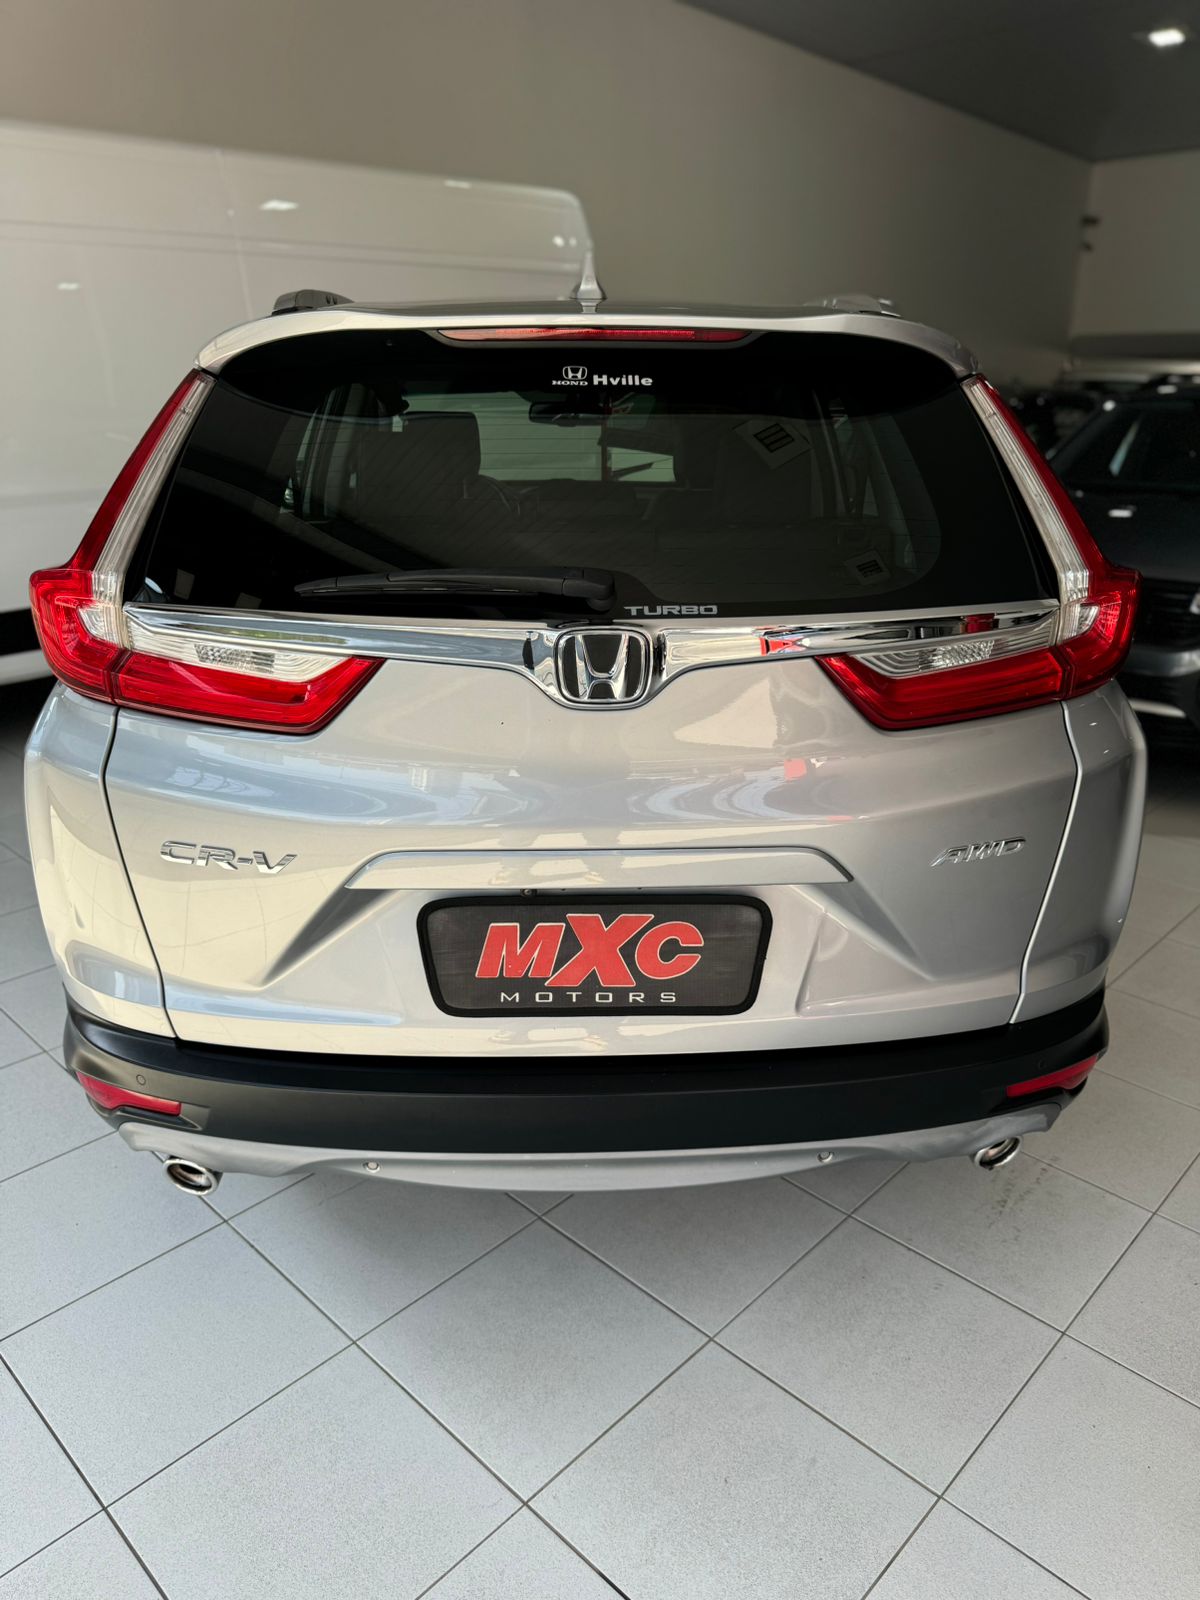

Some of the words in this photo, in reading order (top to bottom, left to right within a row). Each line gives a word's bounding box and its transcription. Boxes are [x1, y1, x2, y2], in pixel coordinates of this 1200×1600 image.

[593, 374, 653, 386] Hville
[623, 605, 718, 616] TURBO
[160, 840, 298, 875] CR-V
[930, 836, 1025, 867] AWD
[475, 913, 705, 988] MXC
[500, 991, 677, 1004] MOTORS
